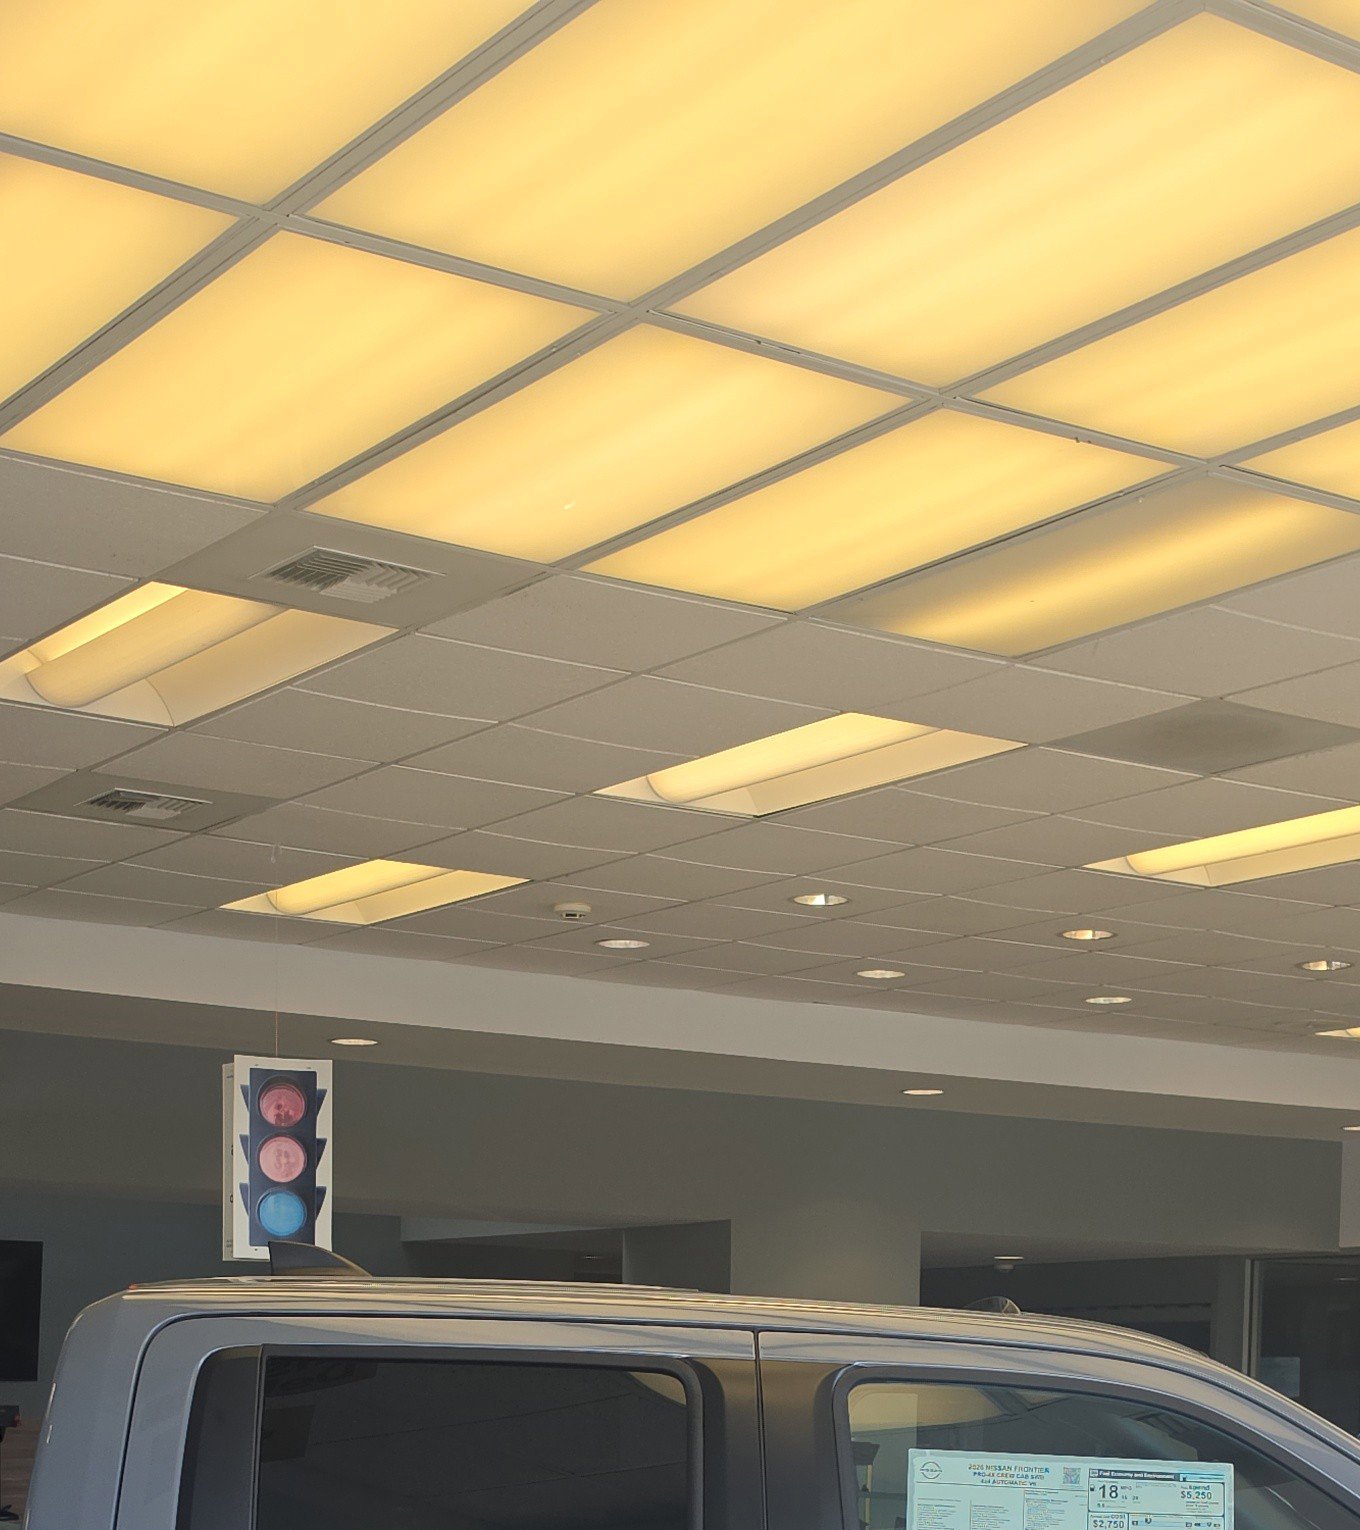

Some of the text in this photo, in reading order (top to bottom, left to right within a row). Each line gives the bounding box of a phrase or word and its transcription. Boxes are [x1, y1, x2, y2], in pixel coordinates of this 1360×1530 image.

[1098, 1484, 1119, 1499] 18
[1180, 1490, 1213, 1500] $5,250
[1093, 1519, 1125, 1529] $2,750
